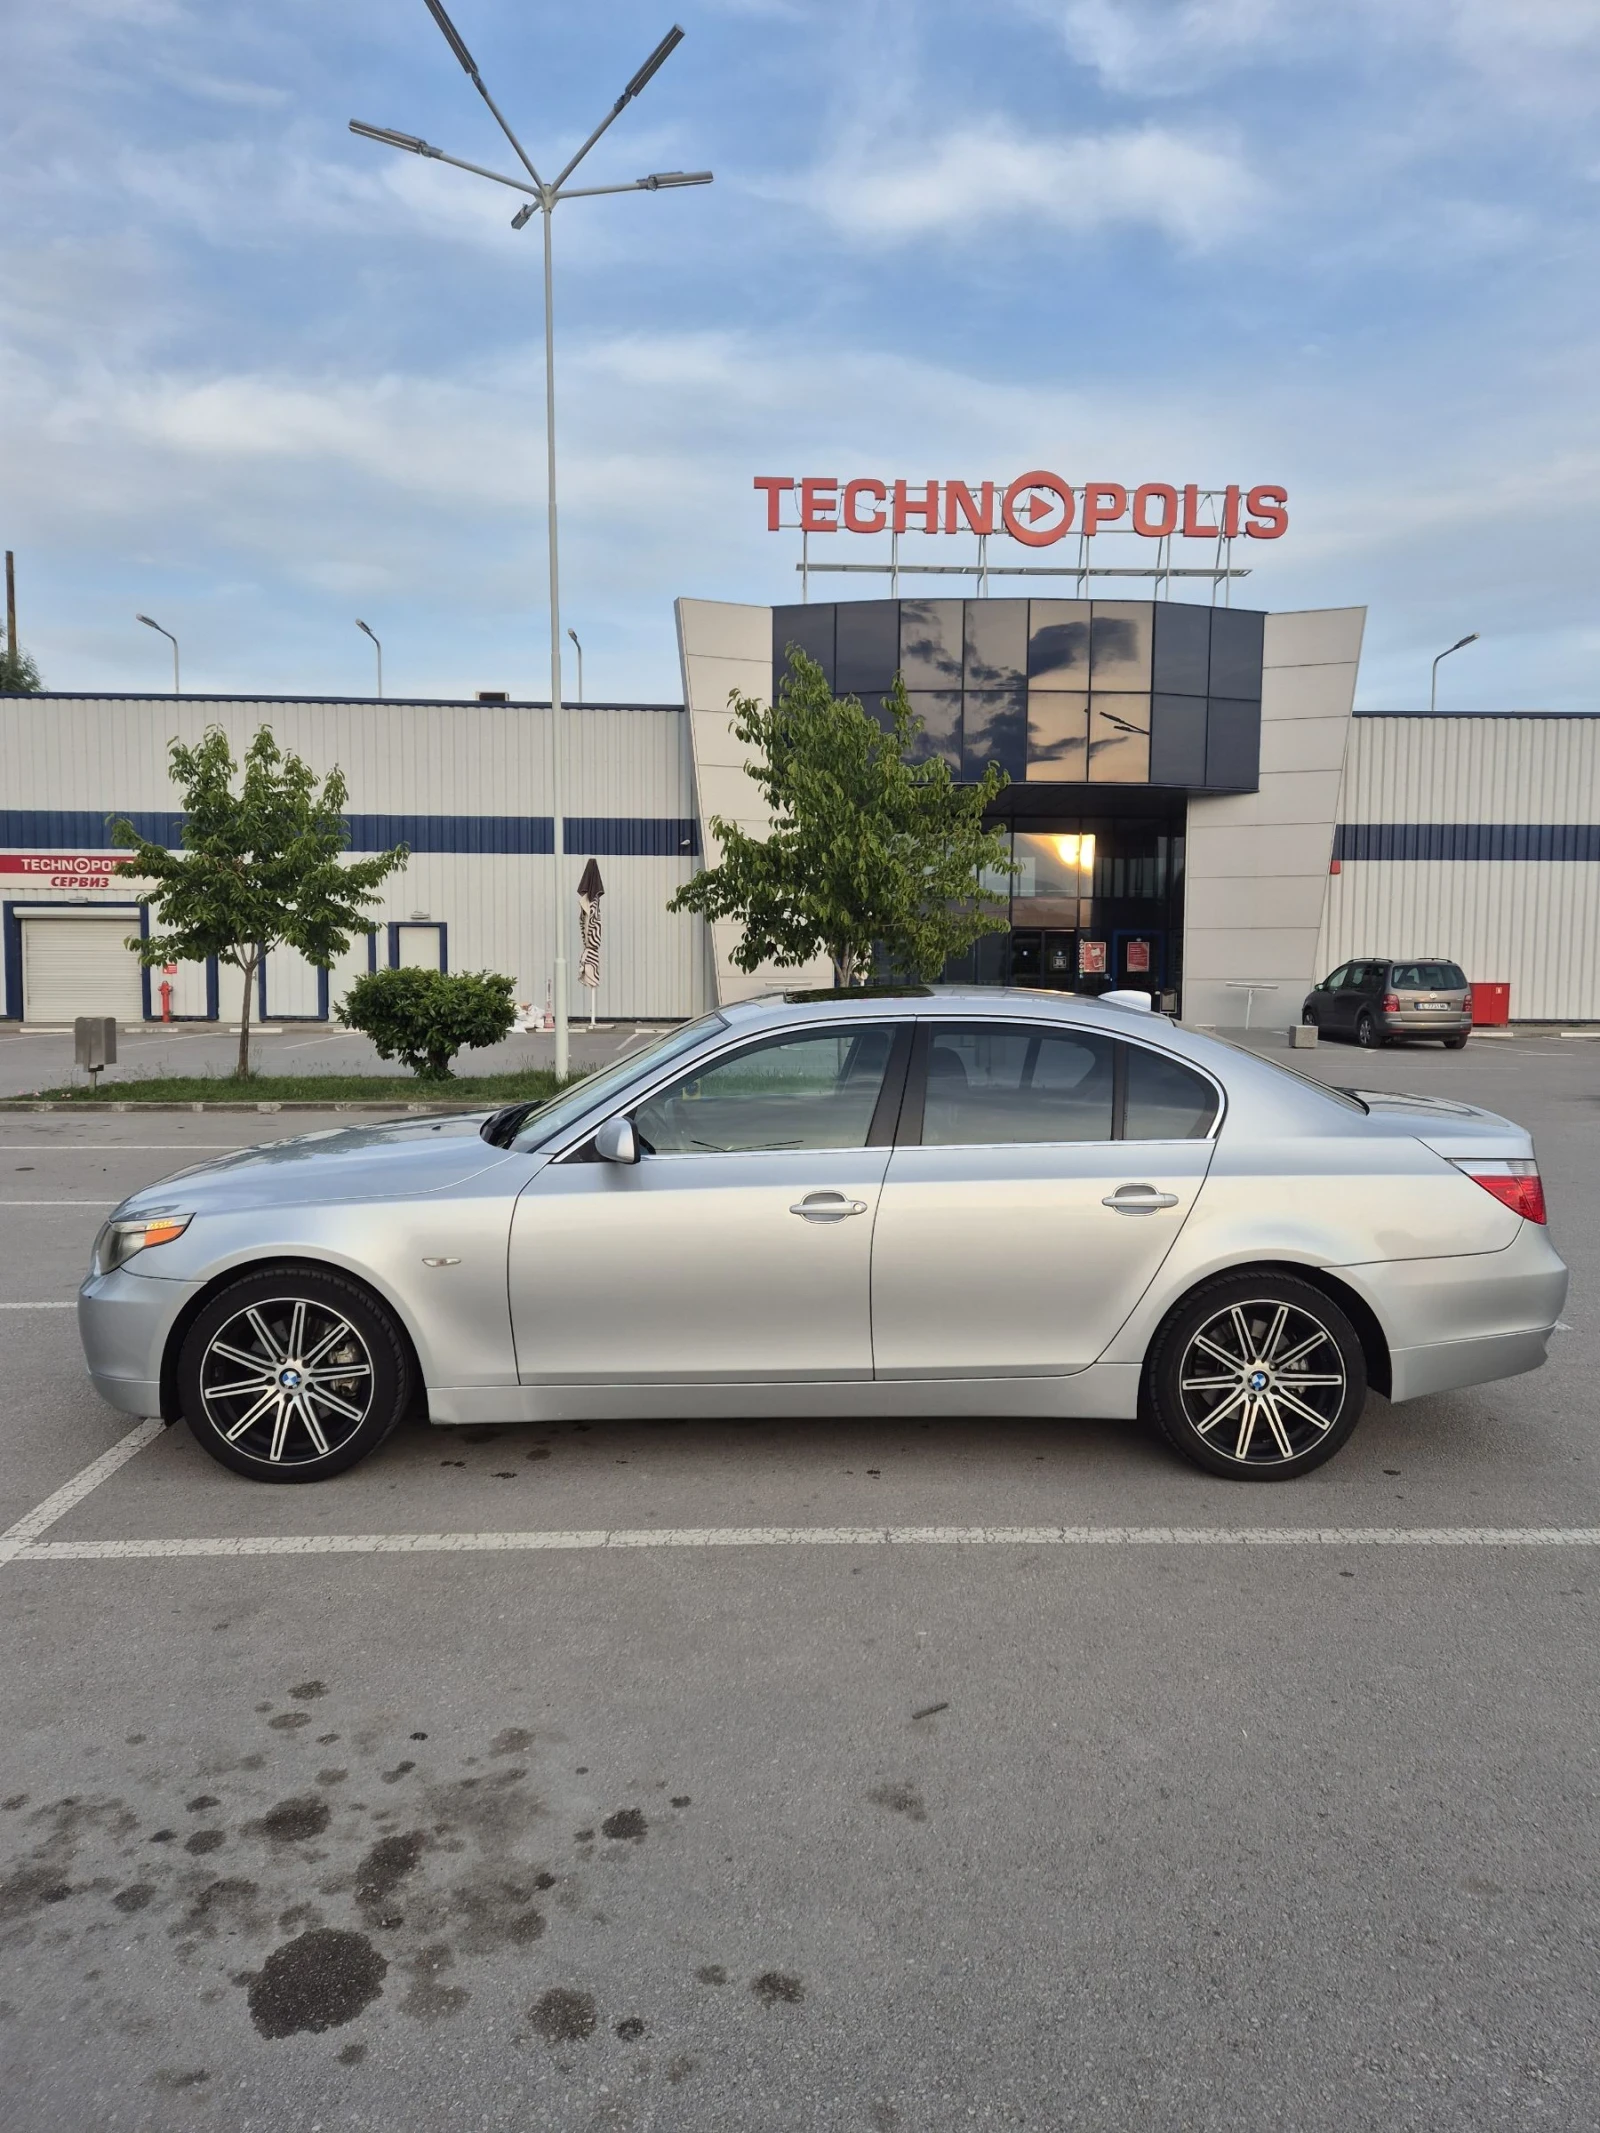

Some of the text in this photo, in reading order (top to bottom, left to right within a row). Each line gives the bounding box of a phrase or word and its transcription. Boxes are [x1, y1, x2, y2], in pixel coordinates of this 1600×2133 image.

[753, 470, 1288, 547] TECHNOPOLIS
[21, 857, 135, 874] TECHNOPO
[50, 876, 110, 888] СЕРВИЗ
